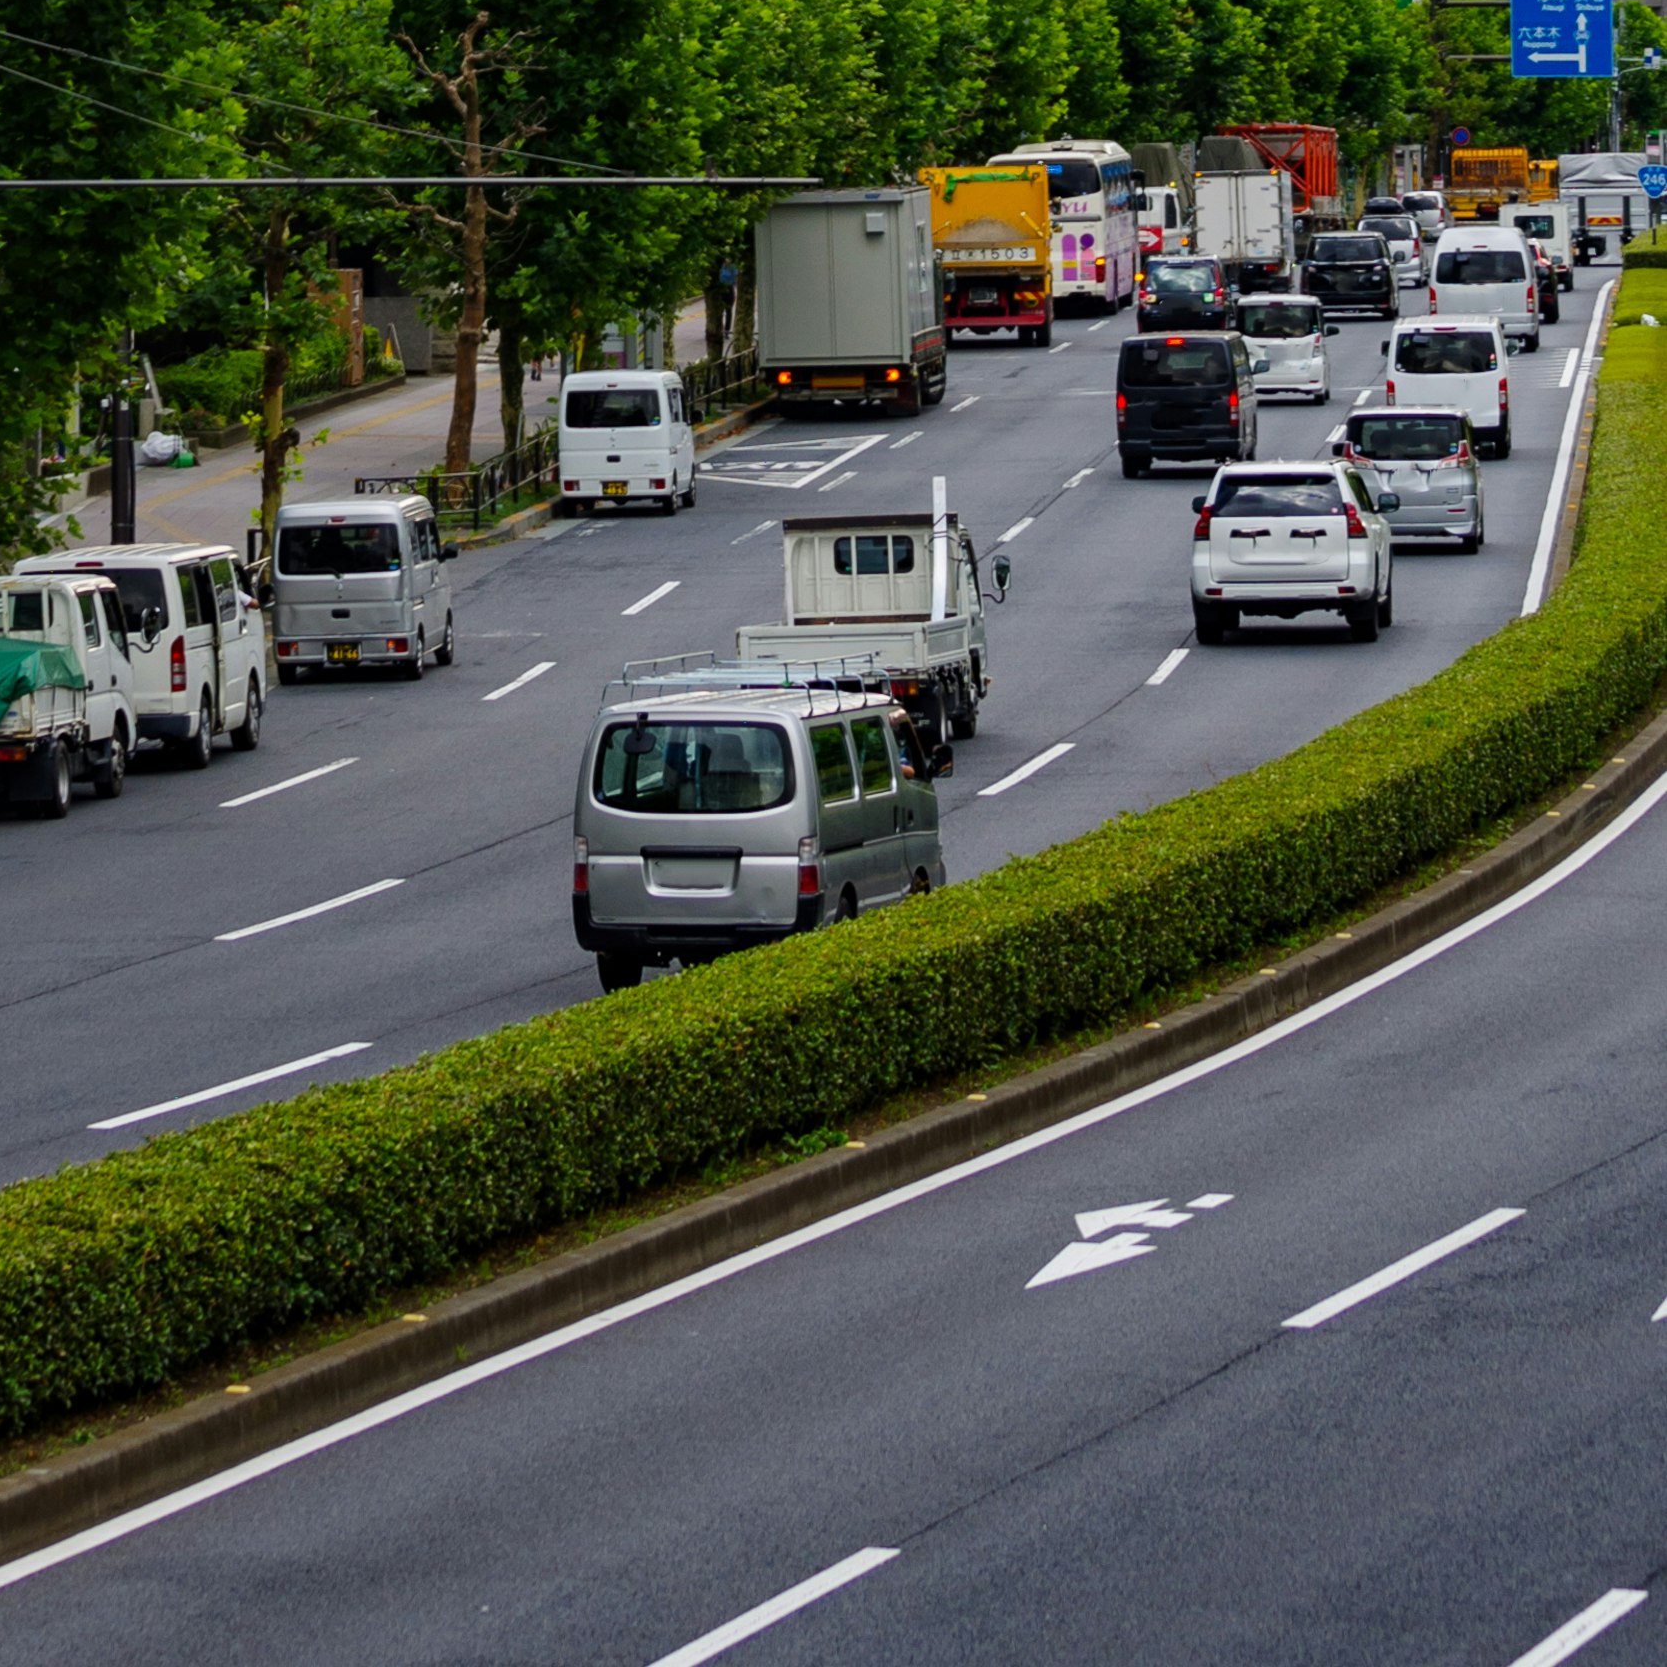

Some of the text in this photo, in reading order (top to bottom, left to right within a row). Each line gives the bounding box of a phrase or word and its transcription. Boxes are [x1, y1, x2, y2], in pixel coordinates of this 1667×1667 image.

[1517, 27, 1561, 39] 六本木
[1643, 173, 1666, 186] 246
